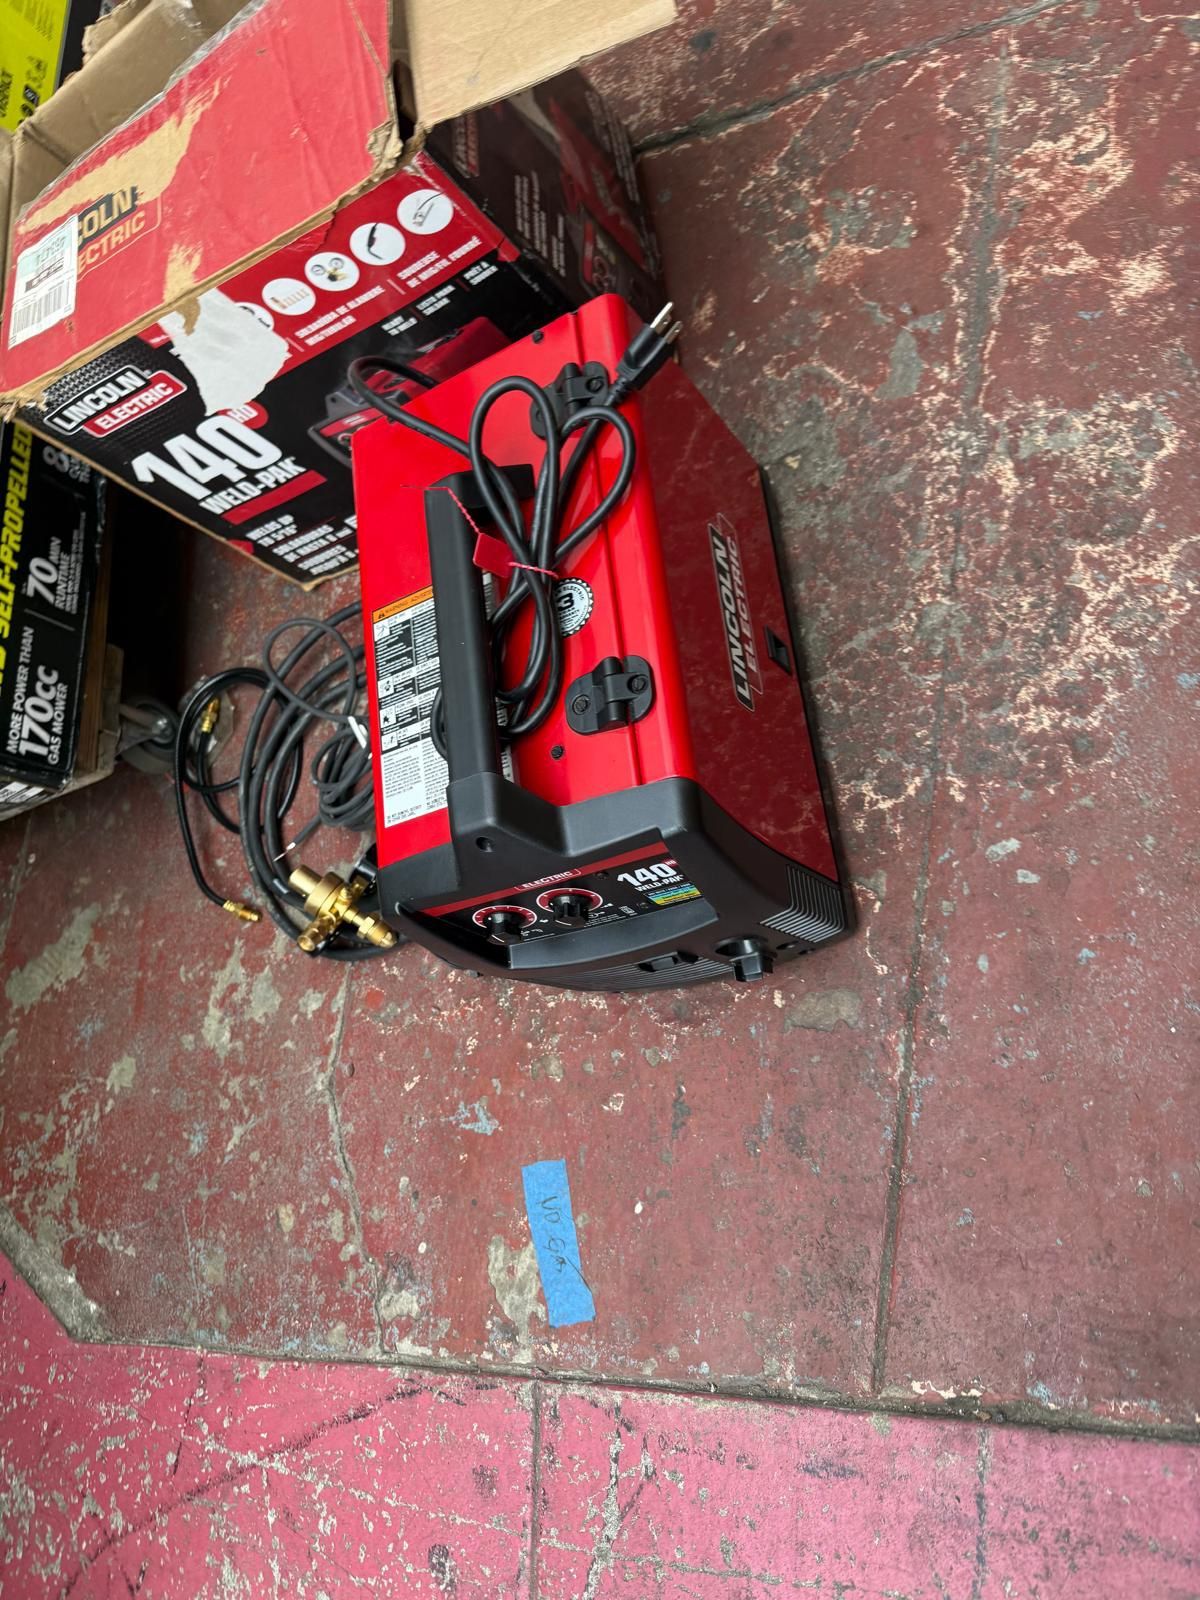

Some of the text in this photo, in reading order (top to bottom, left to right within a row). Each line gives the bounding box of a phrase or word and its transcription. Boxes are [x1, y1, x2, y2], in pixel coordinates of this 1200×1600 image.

[77, 211, 146, 275] ECTRIC
[52, 370, 146, 430] LINCOLN
[94, 383, 174, 430] ELECTRIC
[131, 415, 283, 501] 140
[26, 536, 62, 607] 70 MIN
[54, 551, 71, 611] RUNTIME
[557, 592, 575, 612] 3
[727, 535, 758, 673] ELECTRIC
[712, 535, 751, 701] LINCOLN
[7, 625, 35, 754] MORE POWER THAN
[19, 665, 59, 756] 170cc
[47, 682, 69, 765] GAS MOWER
[521, 870, 574, 890] ELECTRIC
[617, 862, 677, 887] 140
